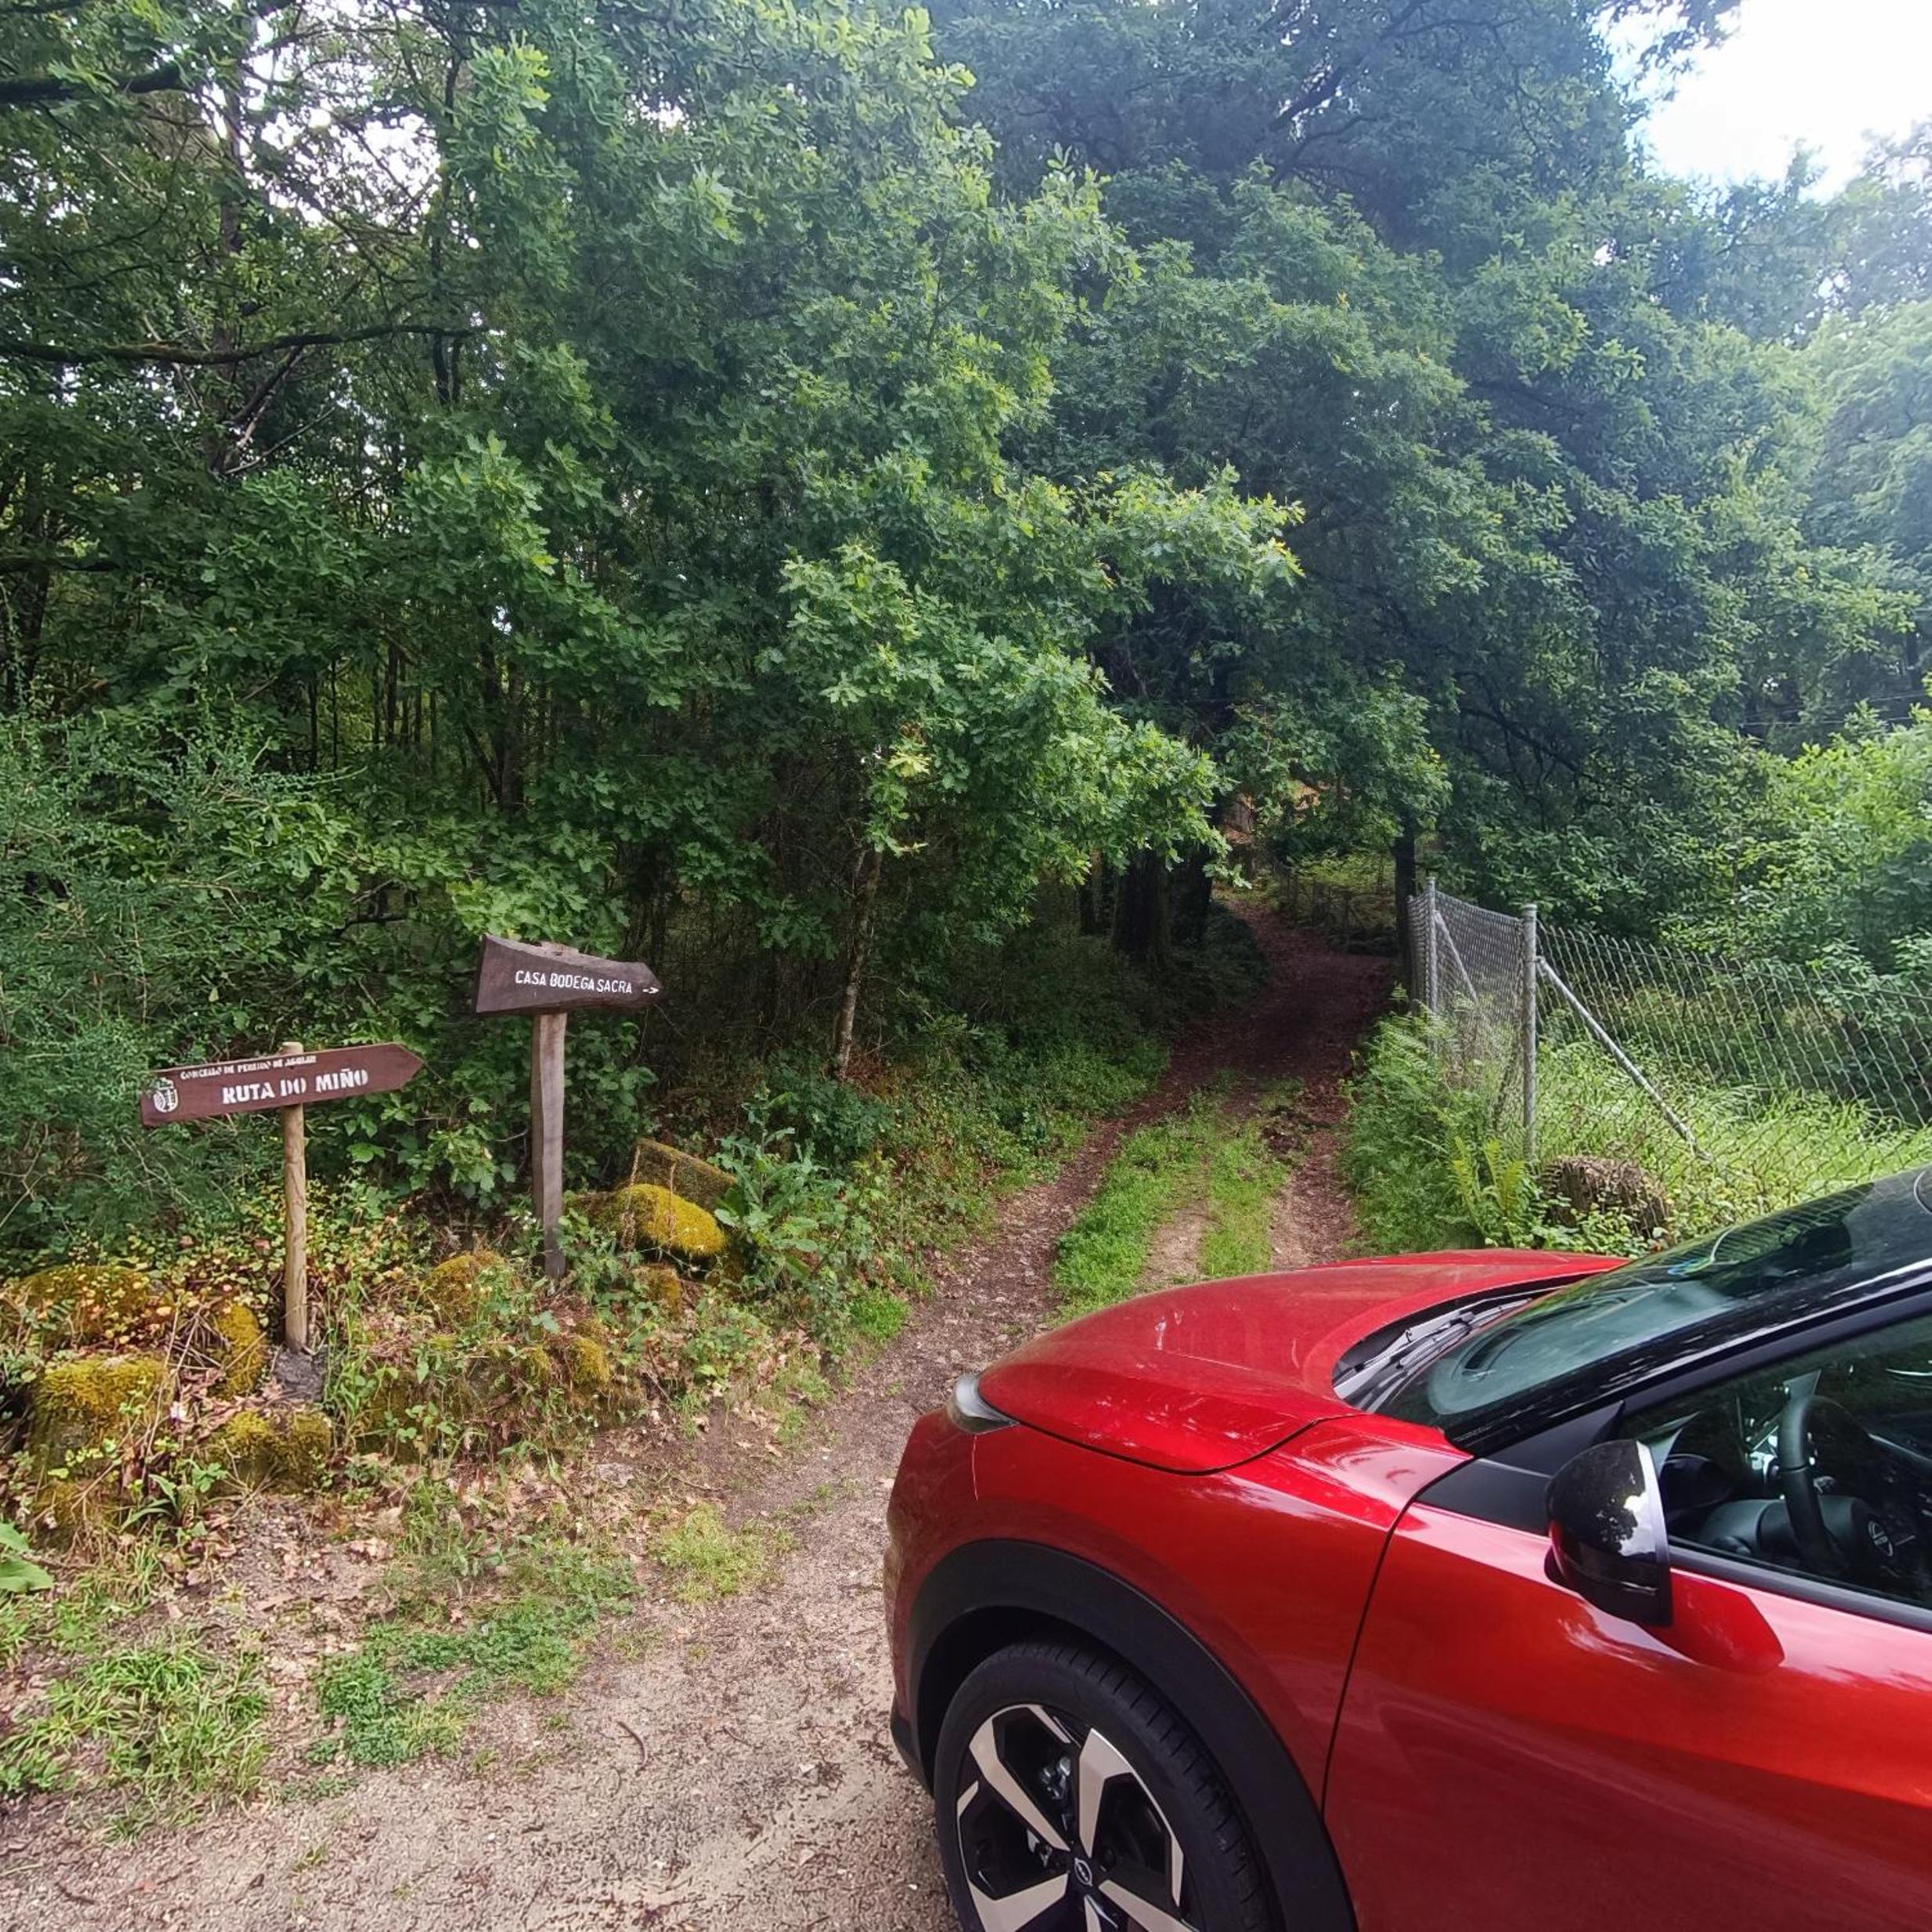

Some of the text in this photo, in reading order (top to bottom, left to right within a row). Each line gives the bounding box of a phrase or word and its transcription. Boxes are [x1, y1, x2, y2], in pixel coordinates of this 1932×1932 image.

[514, 970, 633, 994] CASA BODEGA SACRA
[223, 1065, 234, 1074] DE
[273, 1059, 283, 1068] DE
[222, 1068, 369, 1105] RUTA DO MIÑO
